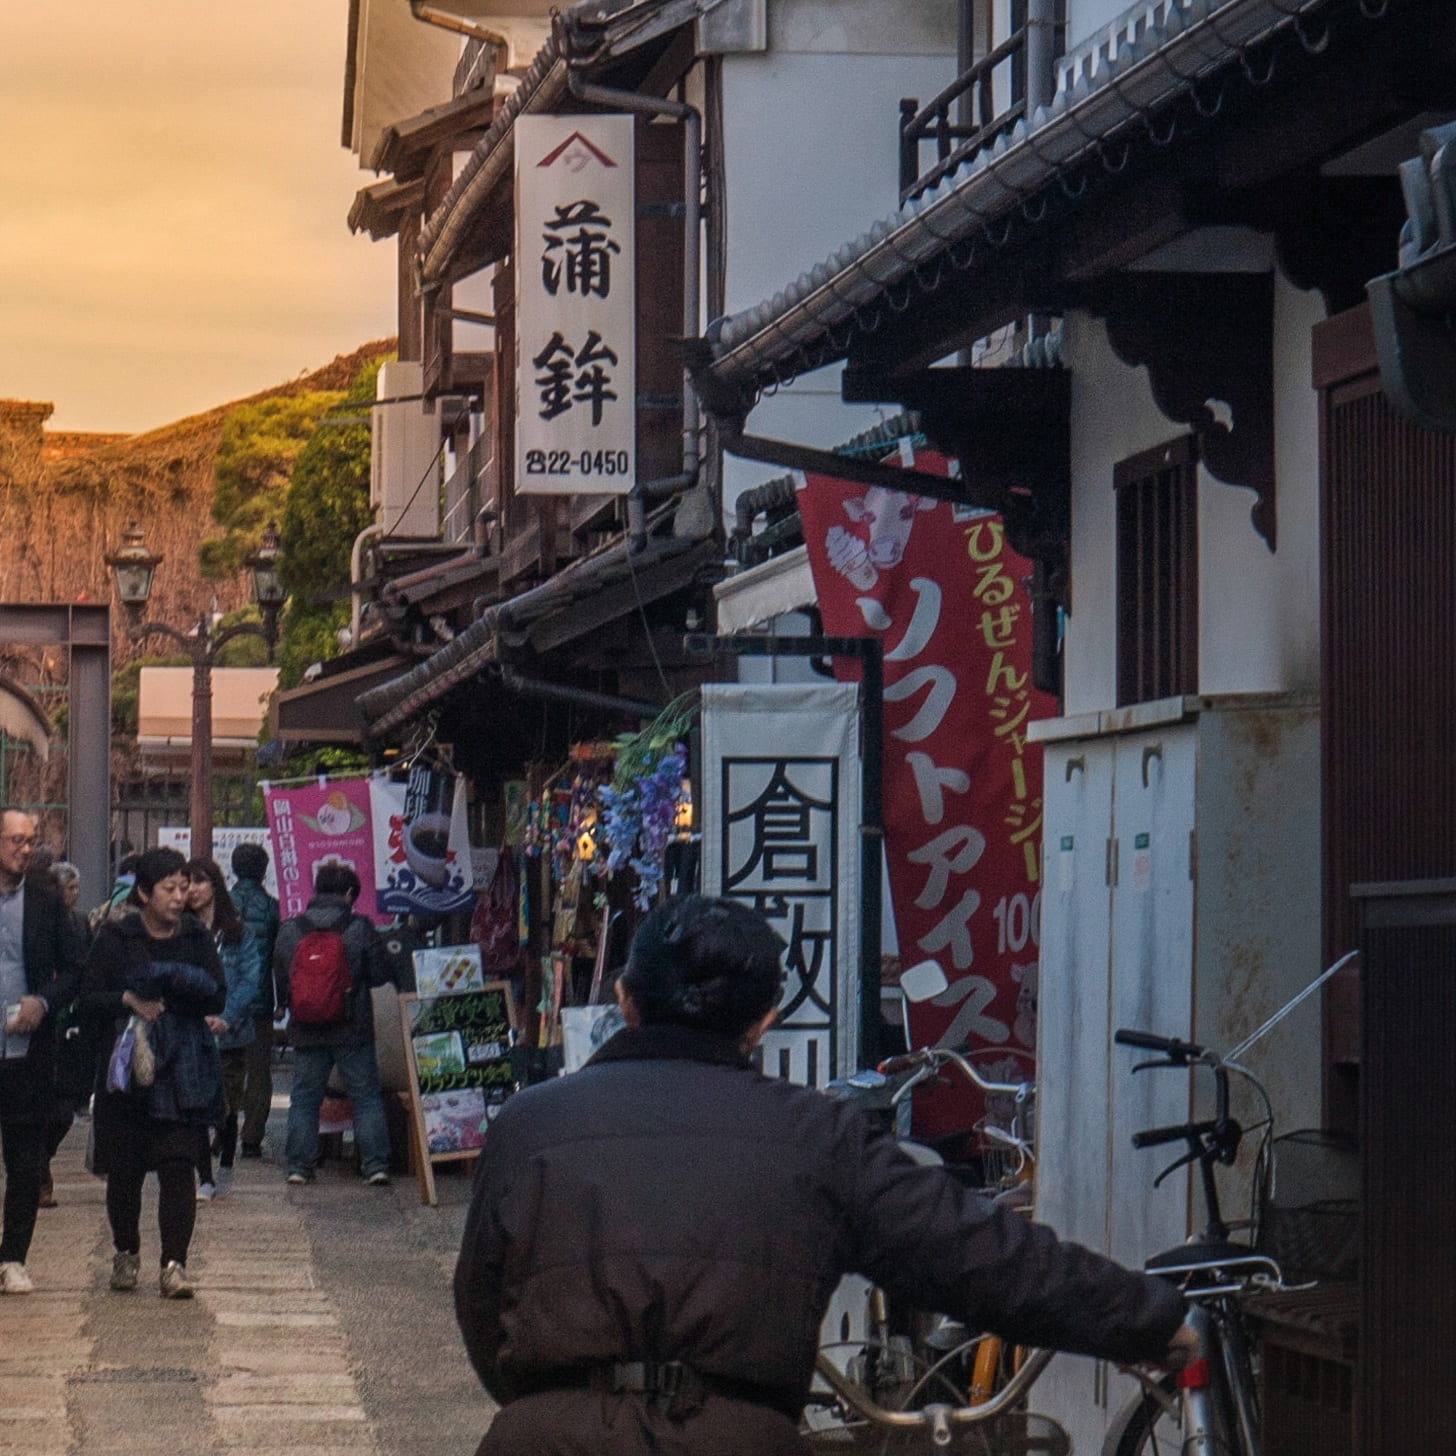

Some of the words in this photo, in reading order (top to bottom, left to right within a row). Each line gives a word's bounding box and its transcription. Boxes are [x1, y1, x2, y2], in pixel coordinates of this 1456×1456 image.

[532, 199, 622, 427] 蒲鉾
[547, 449, 630, 476] 22-0450
[856, 577, 1010, 1048] ソフトアイス
[963, 521, 1043, 883] ひるぜんジャージー
